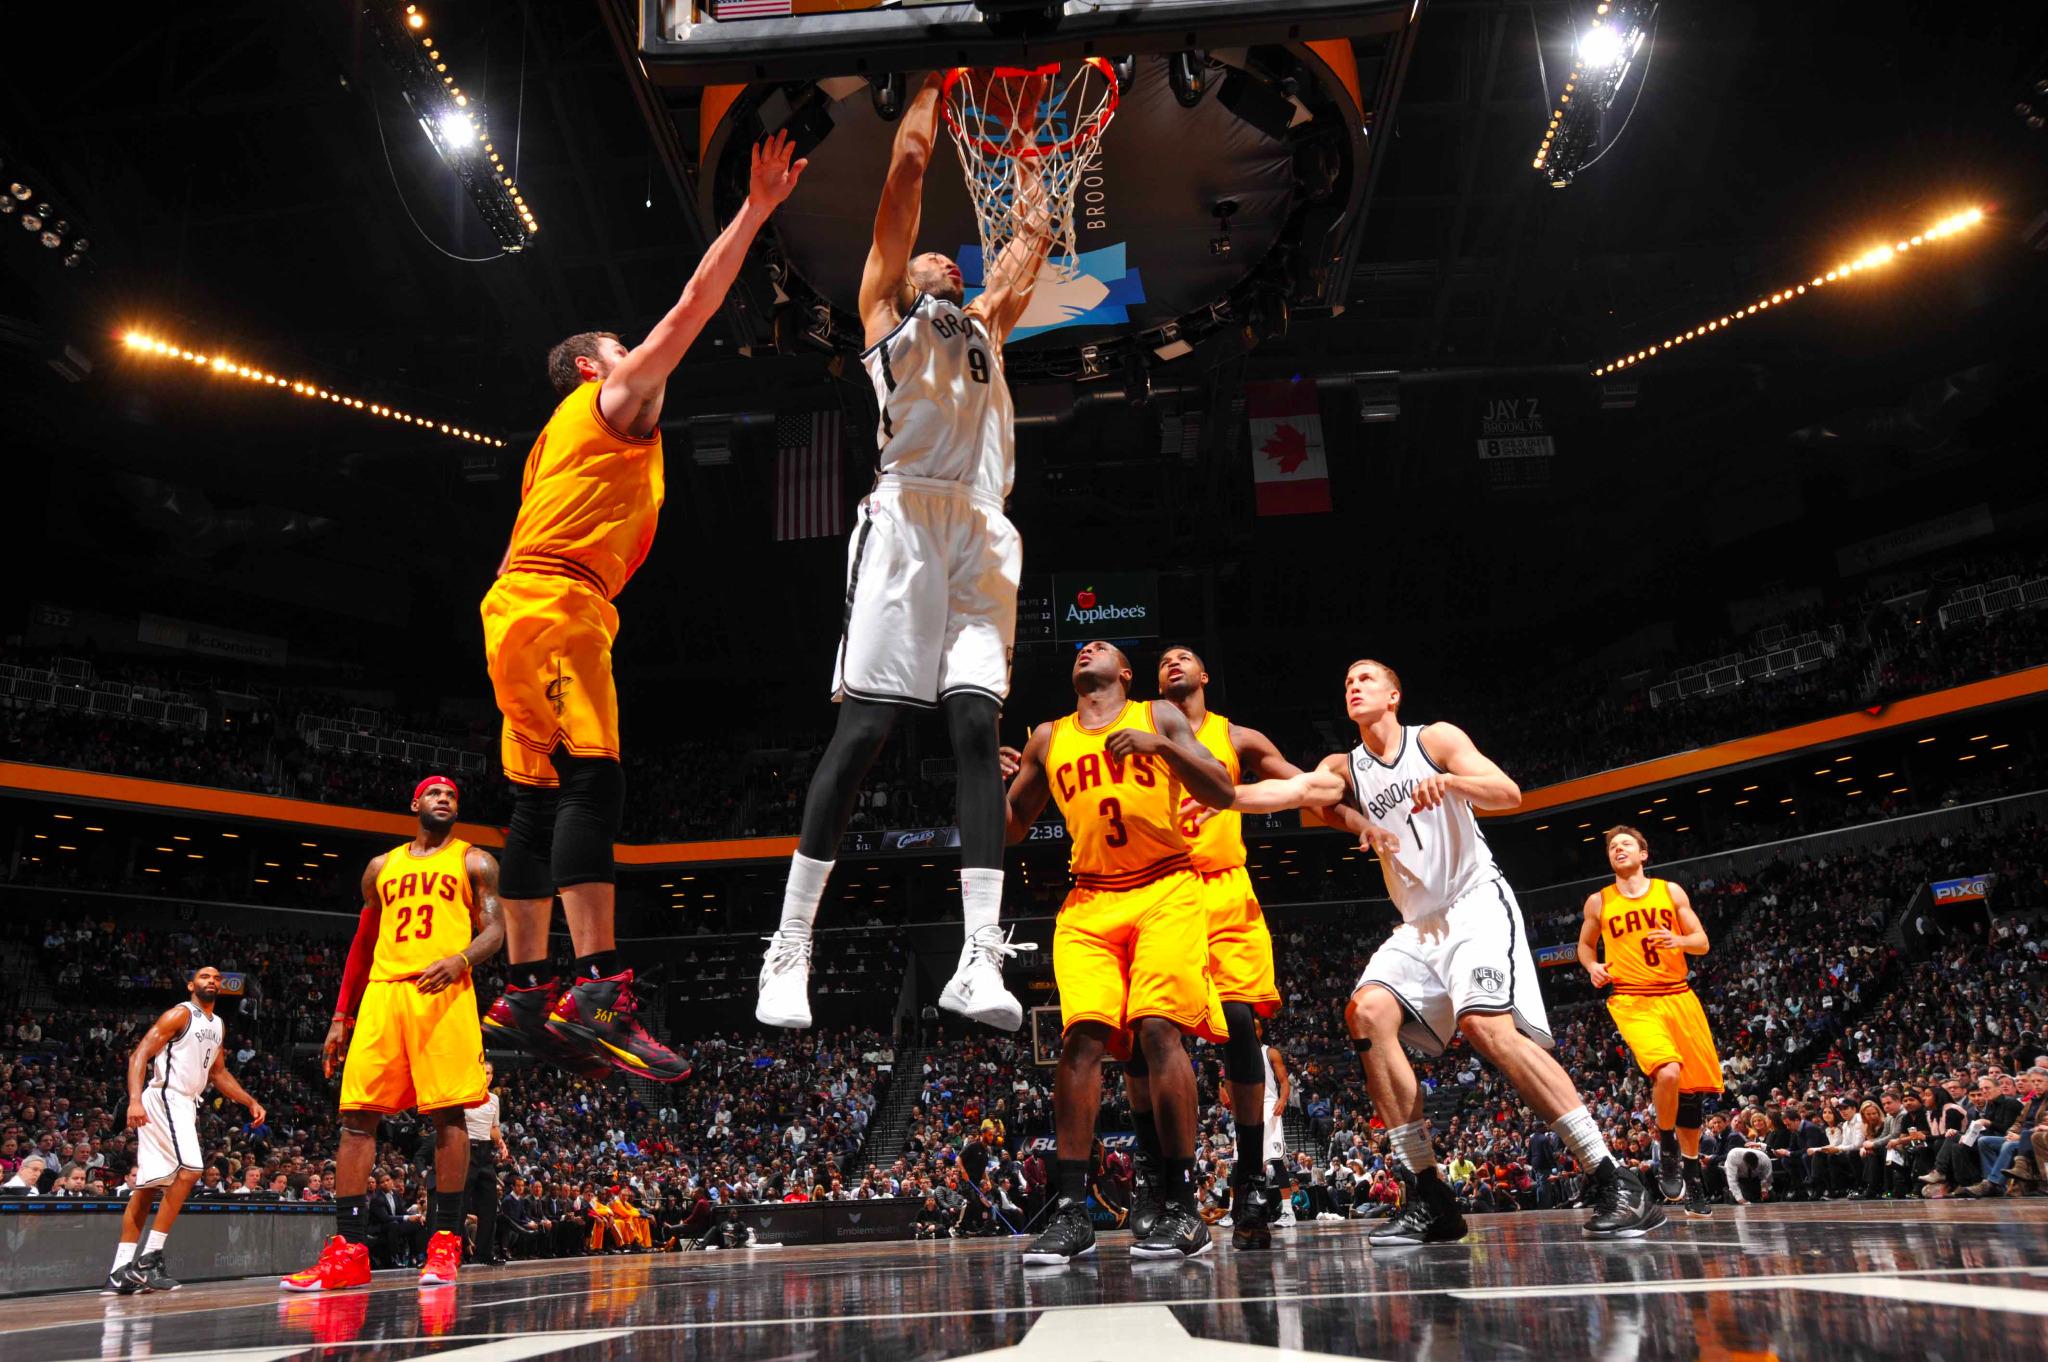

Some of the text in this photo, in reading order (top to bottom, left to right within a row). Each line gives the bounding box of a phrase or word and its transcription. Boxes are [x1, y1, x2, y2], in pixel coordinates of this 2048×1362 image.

[967, 348, 989, 384] 9
[1482, 398, 1541, 421] JAY Z
[1483, 420, 1545, 434] BROOKLYN
[1487, 440, 1500, 456] 8
[1065, 602, 1147, 625] Applebee's
[1056, 750, 1156, 803] CAVS
[1029, 825, 1064, 840] 2:38
[1099, 797, 1128, 849] 3
[1406, 813, 1423, 850] 1
[383, 871, 458, 906] CAVS
[395, 904, 434, 943] 23
[1608, 907, 1673, 938] CAVS
[1475, 968, 1503, 983] NETS
